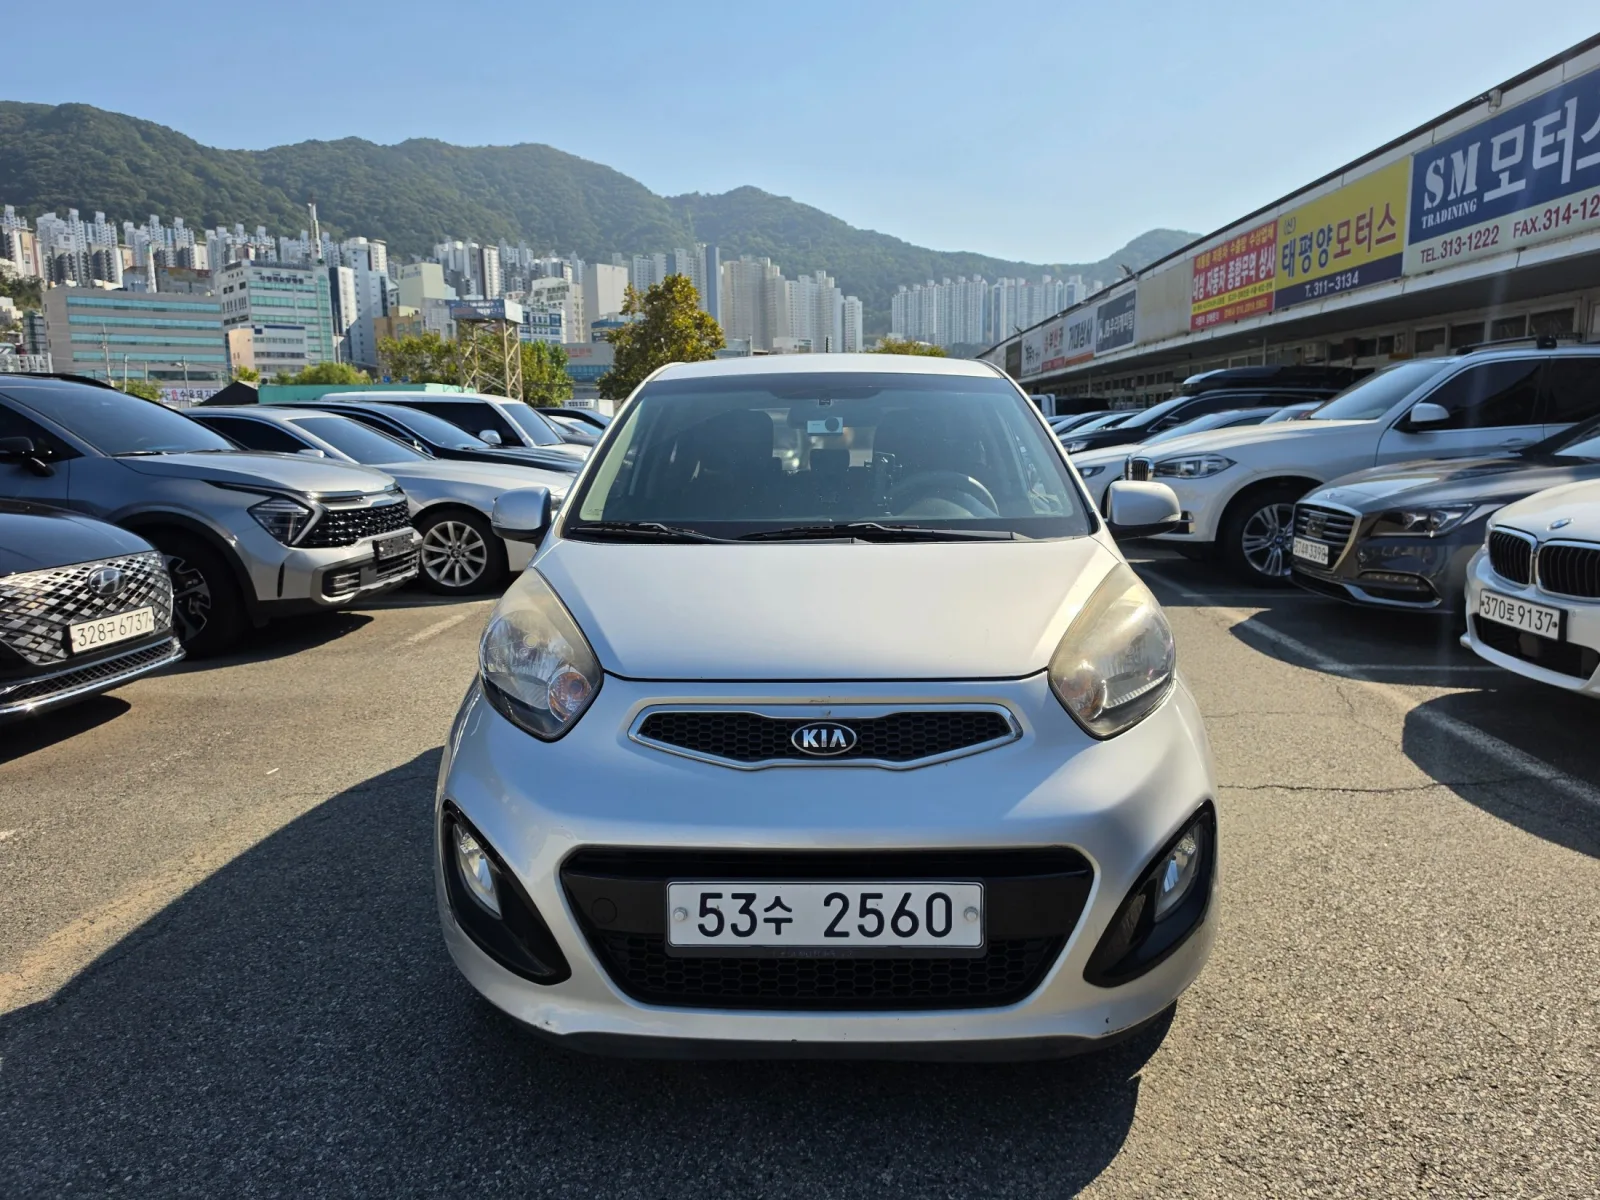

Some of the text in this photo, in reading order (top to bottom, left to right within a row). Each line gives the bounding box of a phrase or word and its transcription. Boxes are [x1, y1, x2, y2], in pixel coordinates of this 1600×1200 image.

[1424, 142, 1481, 210] SM
[1421, 198, 1478, 229] TRADINING
[77, 611, 149, 647] 328구 6737
[1484, 595, 1553, 633] 370로 9137
[802, 729, 847, 748] KIA
[698, 892, 953, 938] 53수 2560
